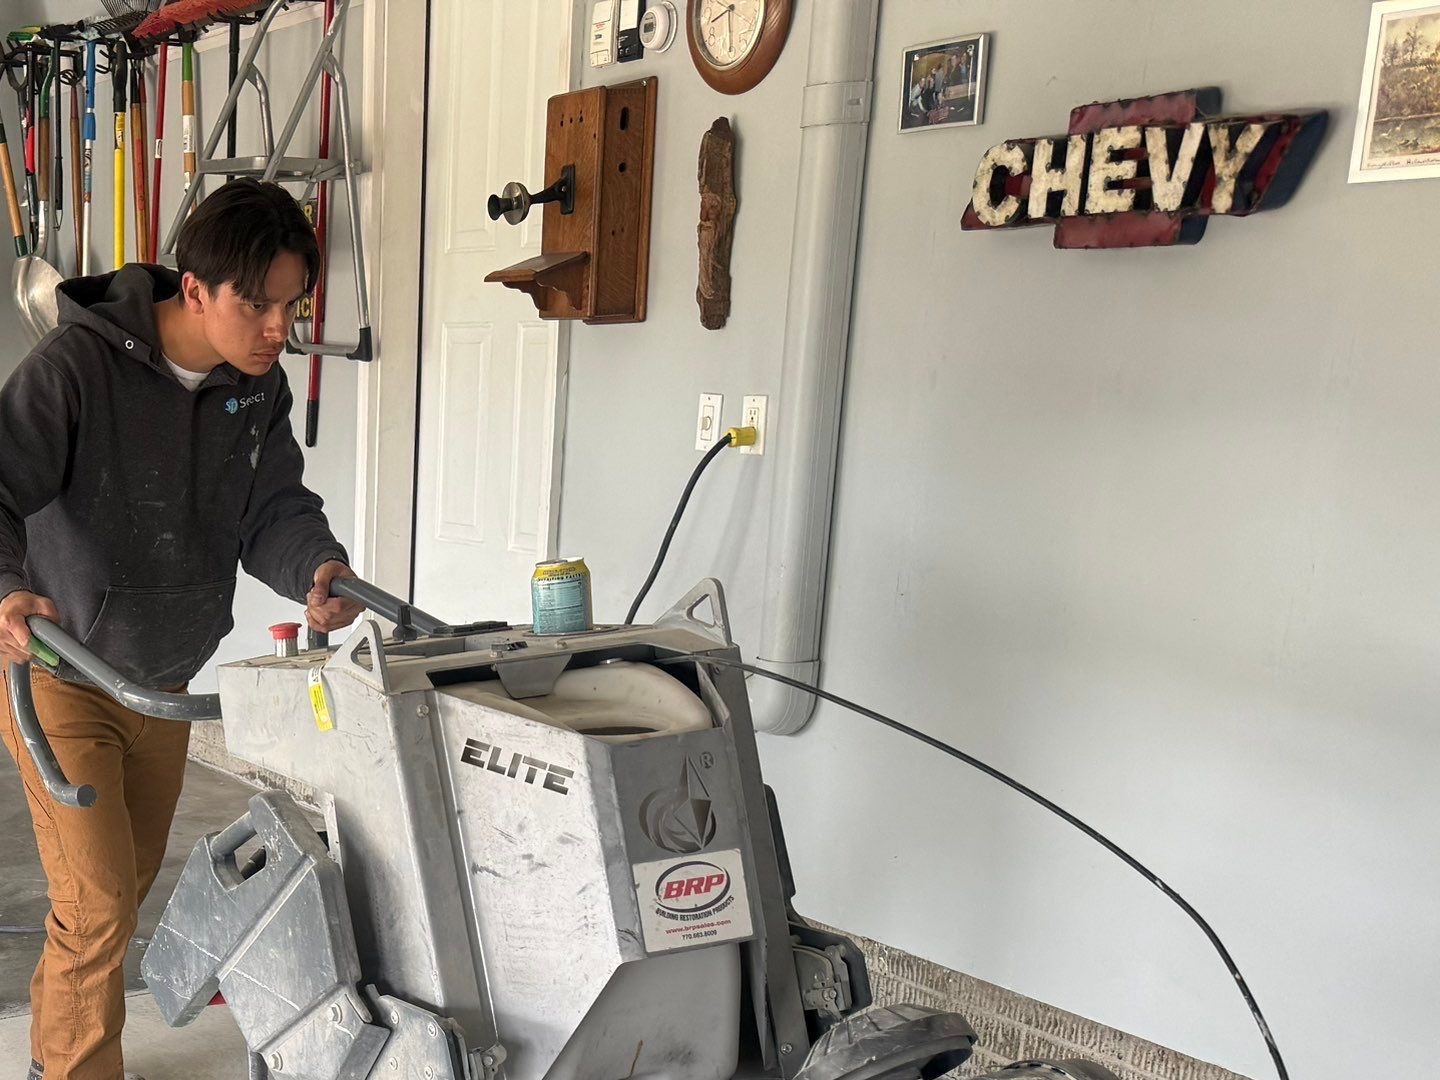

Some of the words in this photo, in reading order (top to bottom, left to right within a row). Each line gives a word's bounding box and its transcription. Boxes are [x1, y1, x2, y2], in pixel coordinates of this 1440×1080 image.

[972, 122, 1266, 227] CHEVY
[460, 737, 575, 796] ELITE
[663, 873, 725, 900] BRP
[655, 906, 679, 921] BUILDING
[679, 911, 713, 922] RESTORATION
[712, 895, 735, 916] PRODUCTS
